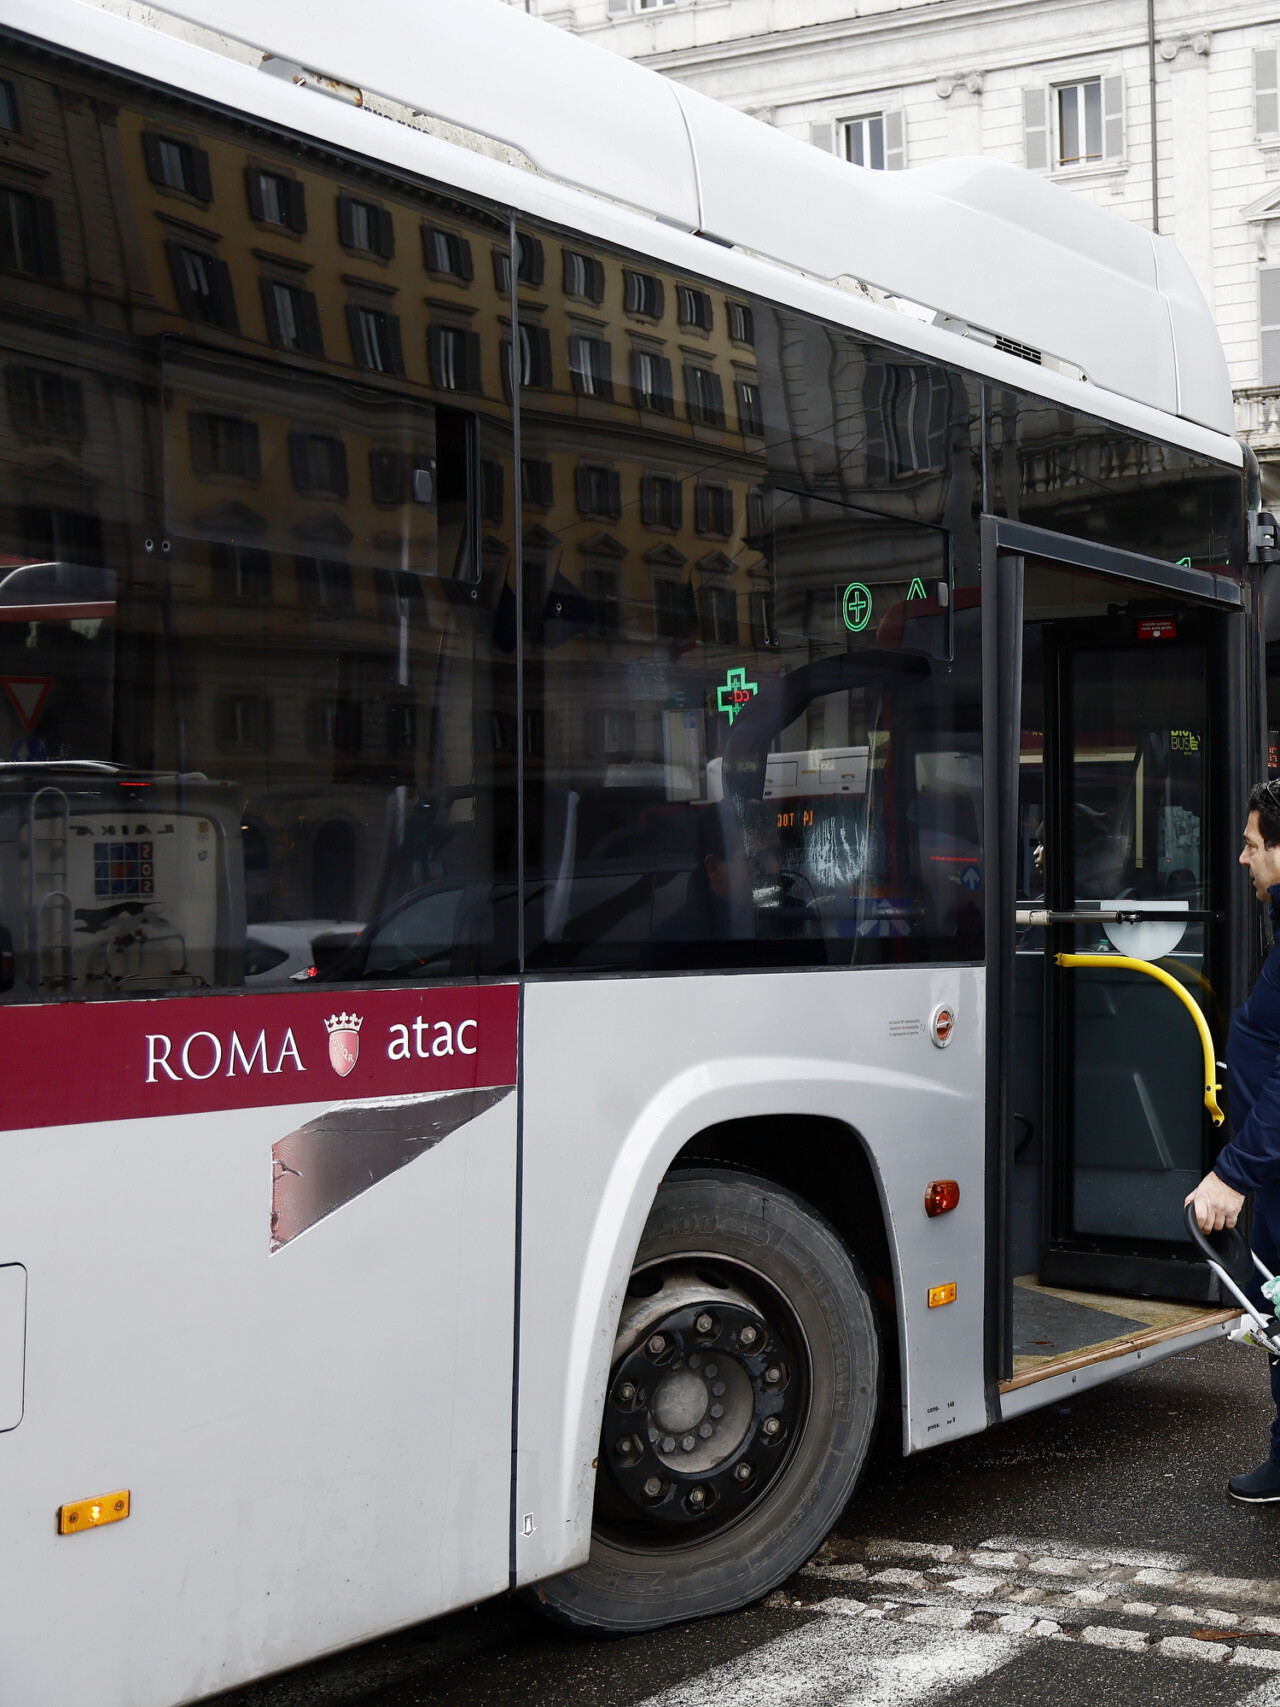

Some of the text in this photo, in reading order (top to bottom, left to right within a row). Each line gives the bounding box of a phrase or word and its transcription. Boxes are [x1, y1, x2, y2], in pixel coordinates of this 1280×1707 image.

[1171, 736, 1190, 750] BUS
[145, 1015, 478, 1083] ROMA atac
